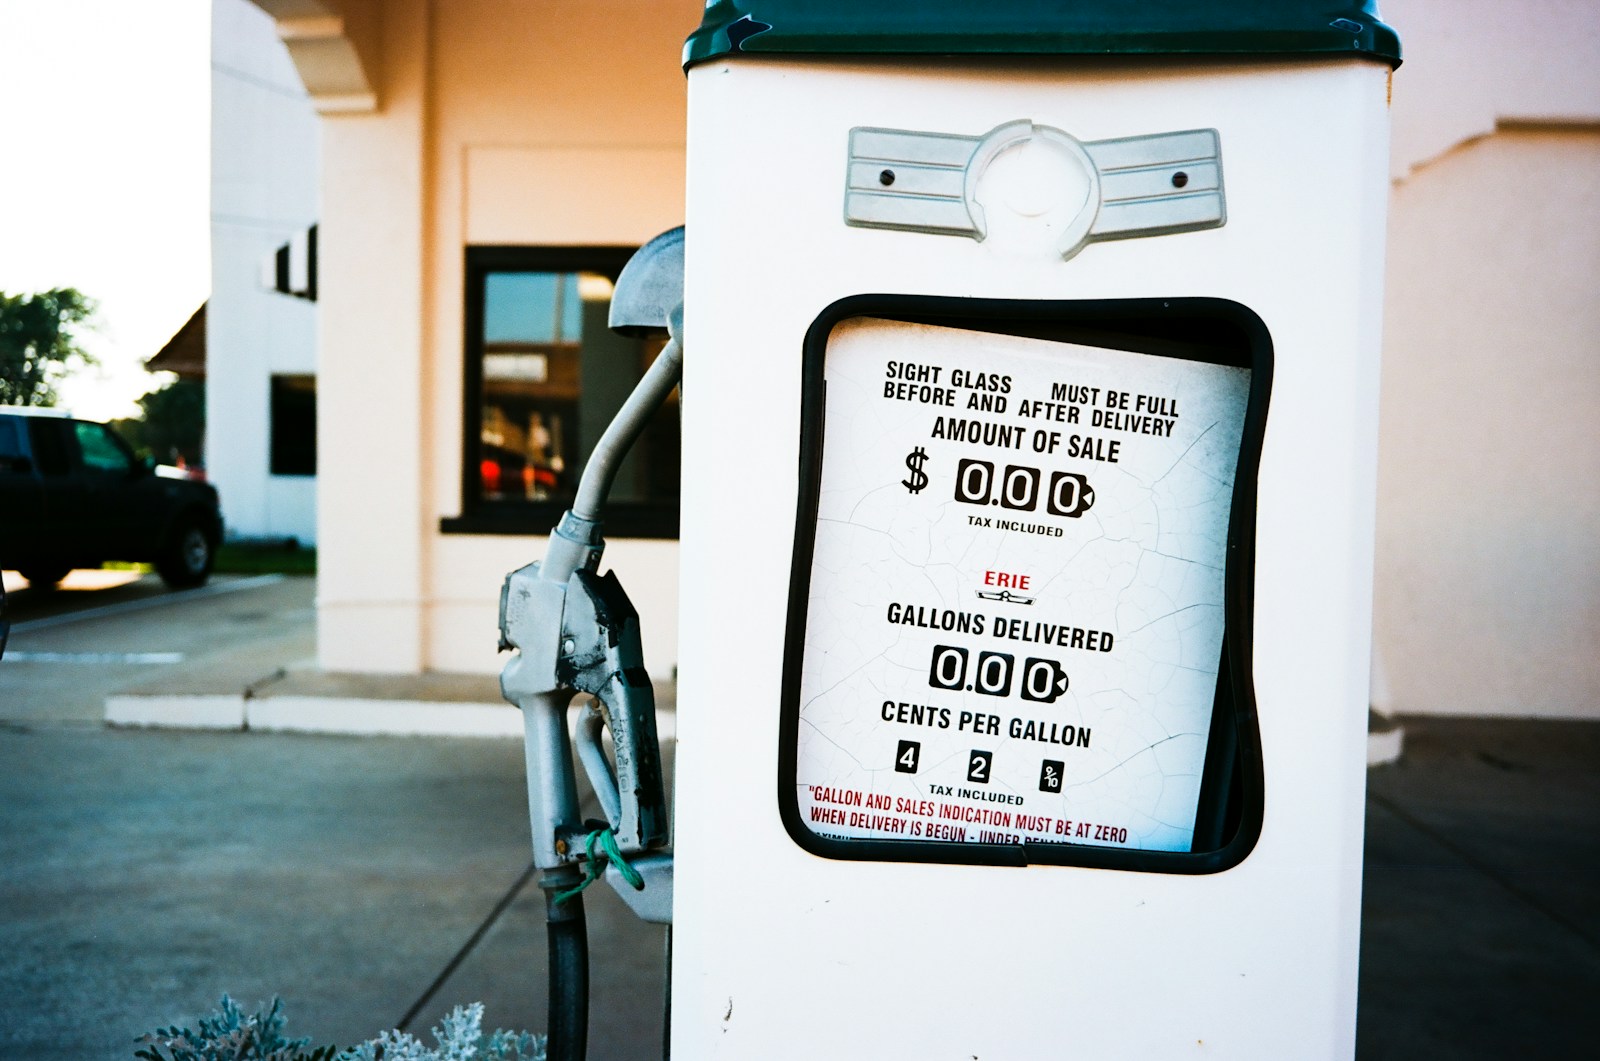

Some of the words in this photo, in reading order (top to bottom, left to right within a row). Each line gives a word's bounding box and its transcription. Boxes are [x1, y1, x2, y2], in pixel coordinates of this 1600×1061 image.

[884, 381, 956, 406] BEFORE
[967, 393, 1007, 413] AND
[1018, 400, 1080, 424] AFTER
[1092, 410, 1175, 437] DELIVERY
[886, 361, 942, 383] SIGHT
[952, 369, 1011, 393] GLASS
[1051, 383, 1100, 405] MUST
[1106, 391, 1129, 410] BE
[1136, 395, 1178, 417] FULL
[931, 417, 1026, 449] AMOUNT
[1033, 430, 1061, 454] OF
[1068, 435, 1120, 463] SALE
[902, 446, 929, 494] $
[968, 516, 991, 527] TAX
[997, 520, 1063, 537] INCLUDED
[985, 571, 1030, 590] ERIE
[888, 603, 985, 635] GALLONS
[993, 617, 1113, 652] DELIVERED
[882, 701, 951, 728] CENTS
[959, 711, 1000, 735] PER
[1009, 718, 1091, 748] GALLON
[900, 747, 915, 768] 4
[970, 756, 986, 778] 2
[809, 786, 862, 806] "GALLON
[866, 794, 891, 810] AND
[896, 798, 934, 816] SALES
[939, 804, 1011, 827] INDICATION
[1016, 814, 1052, 832] MUST
[1056, 820, 1072, 836] BE
[1075, 823, 1091, 838] AT
[1094, 825, 1127, 843] ZERO
[930, 785, 952, 796] TAX
[958, 789, 1023, 805] INCLUDED
[811, 807, 846, 825] WHEN
[850, 812, 906, 833] DELIVERY
[910, 821, 922, 836] IS
[925, 824, 967, 843] BEGUN
